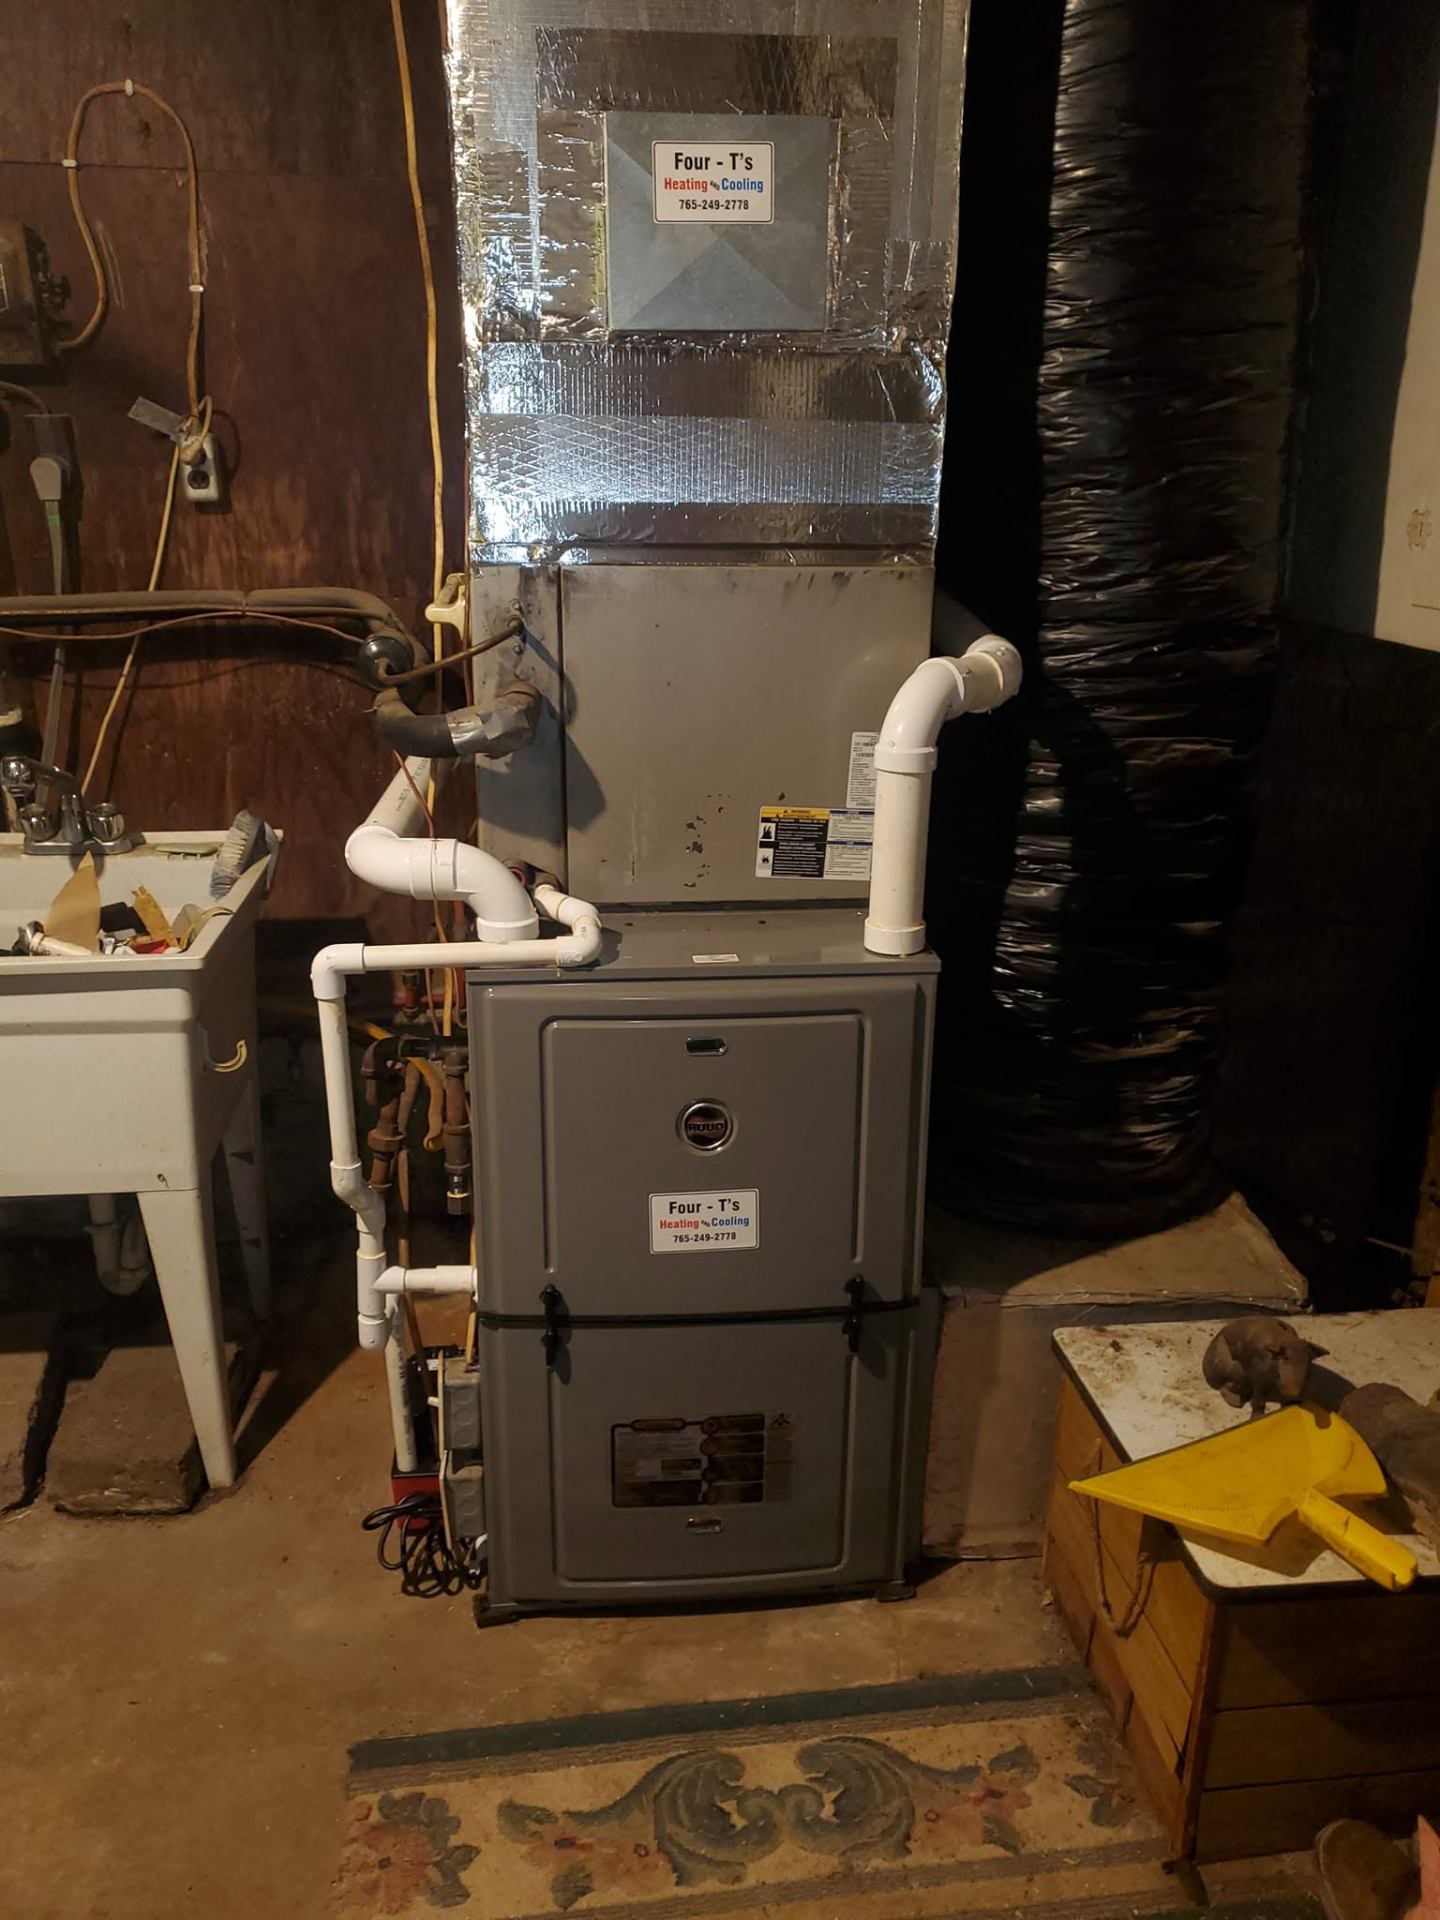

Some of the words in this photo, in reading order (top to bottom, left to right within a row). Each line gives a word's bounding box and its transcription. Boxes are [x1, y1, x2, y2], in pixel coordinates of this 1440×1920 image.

[674, 152, 711, 170] Four
[729, 152, 753, 171] T's
[664, 177, 708, 193] Heating
[721, 177, 764, 193] Cooling
[678, 199, 750, 210] 765-249-2778
[669, 1201, 702, 1214] Four
[718, 1198, 740, 1212] T's
[659, 1218, 700, 1230] Heating
[711, 1216, 750, 1227] Cooling
[673, 1232, 737, 1243] 765-249-2778
